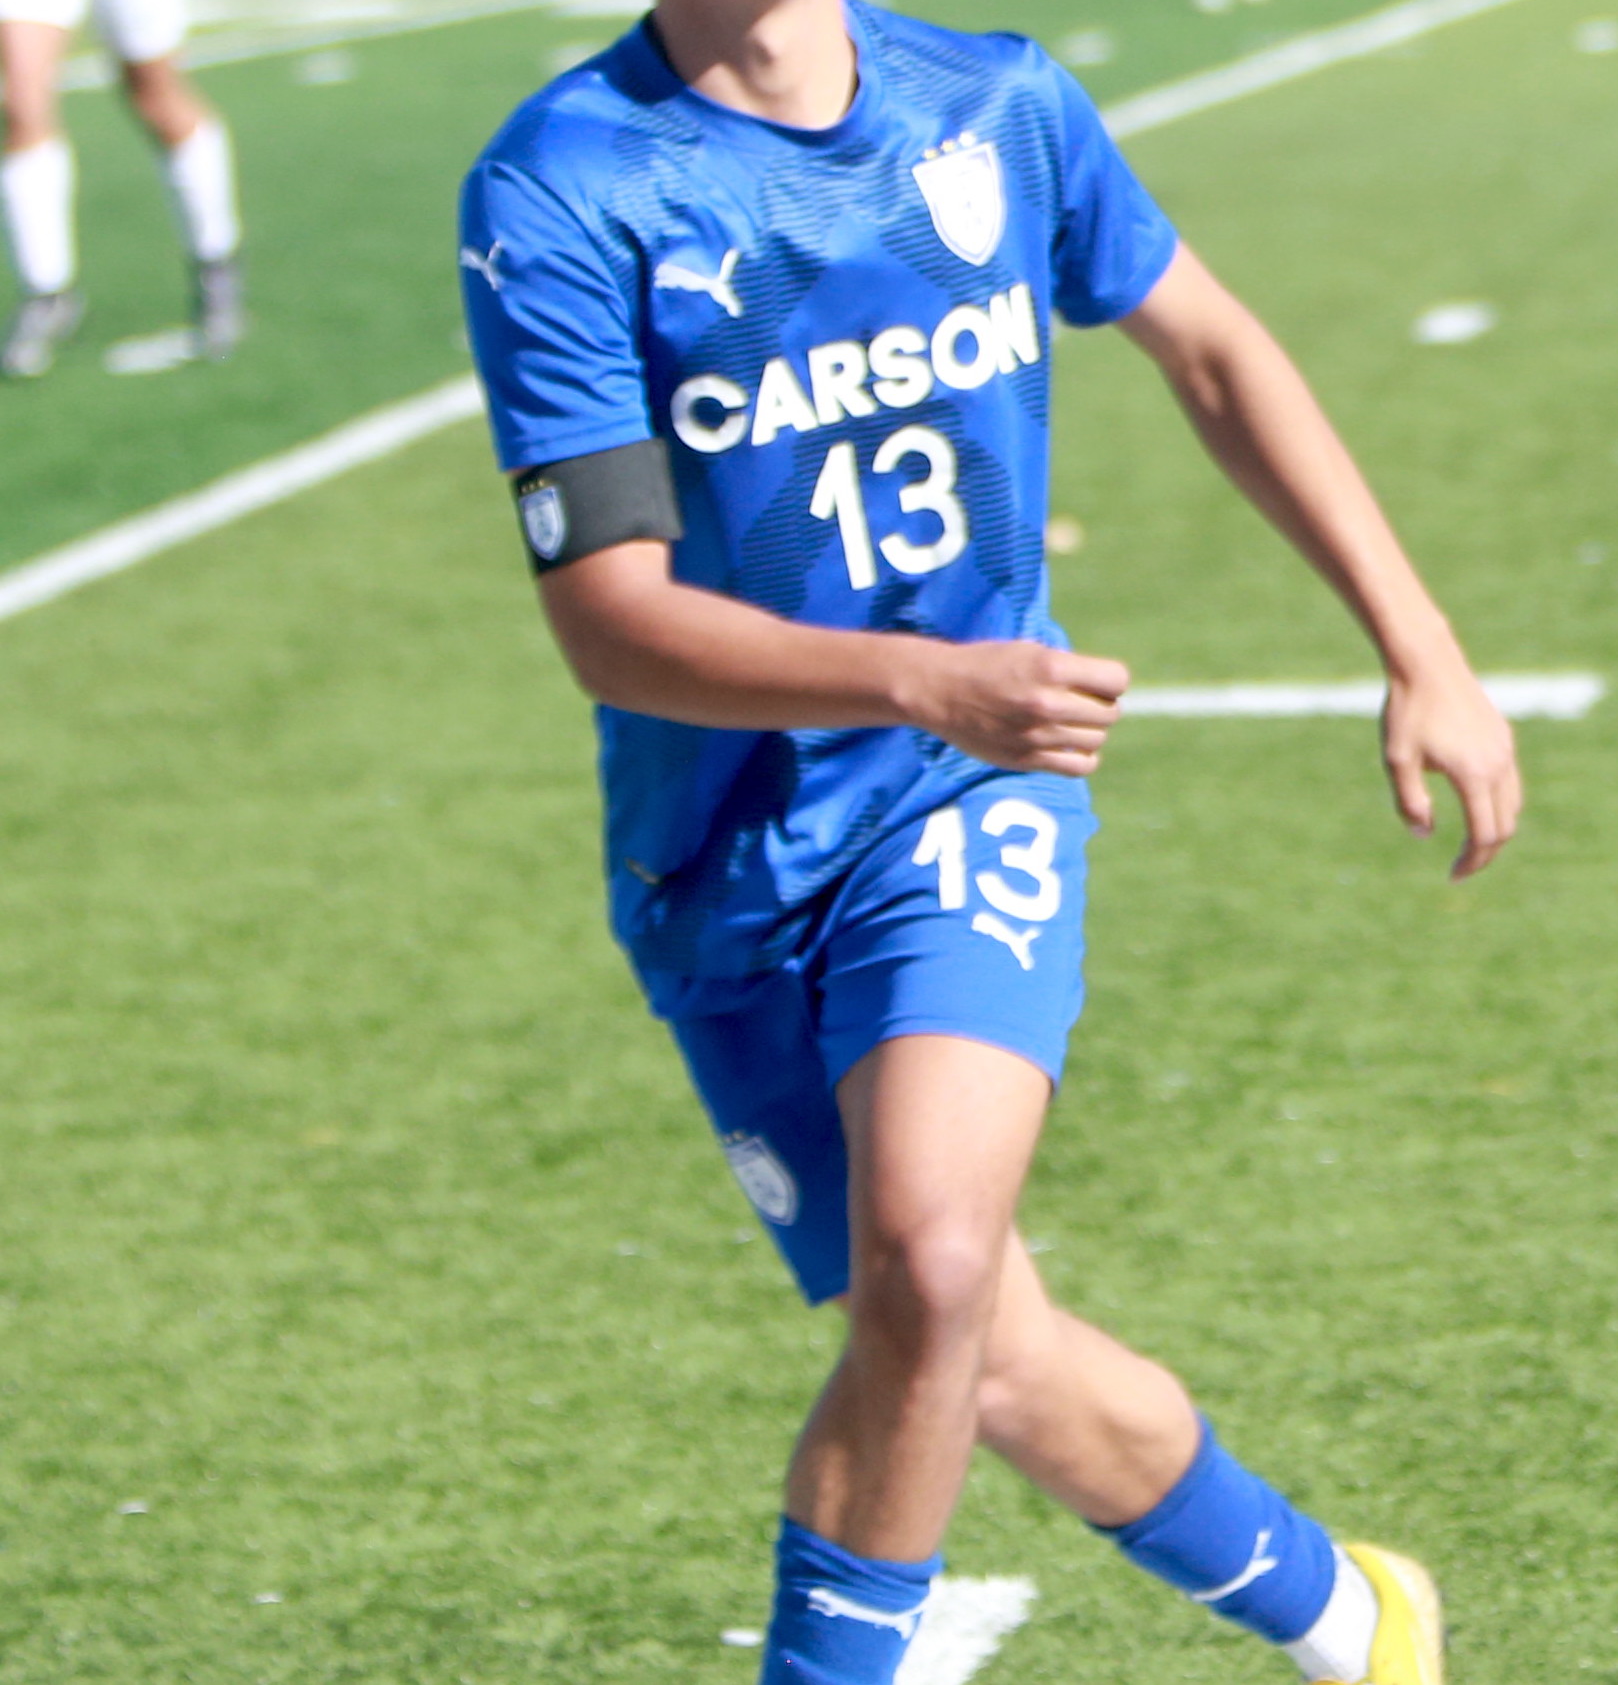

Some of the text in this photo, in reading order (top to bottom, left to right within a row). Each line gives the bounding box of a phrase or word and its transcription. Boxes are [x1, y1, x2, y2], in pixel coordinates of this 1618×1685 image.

[670, 282, 1041, 454] CARSON
[808, 423, 970, 592] 13
[911, 798, 1063, 922] 13
